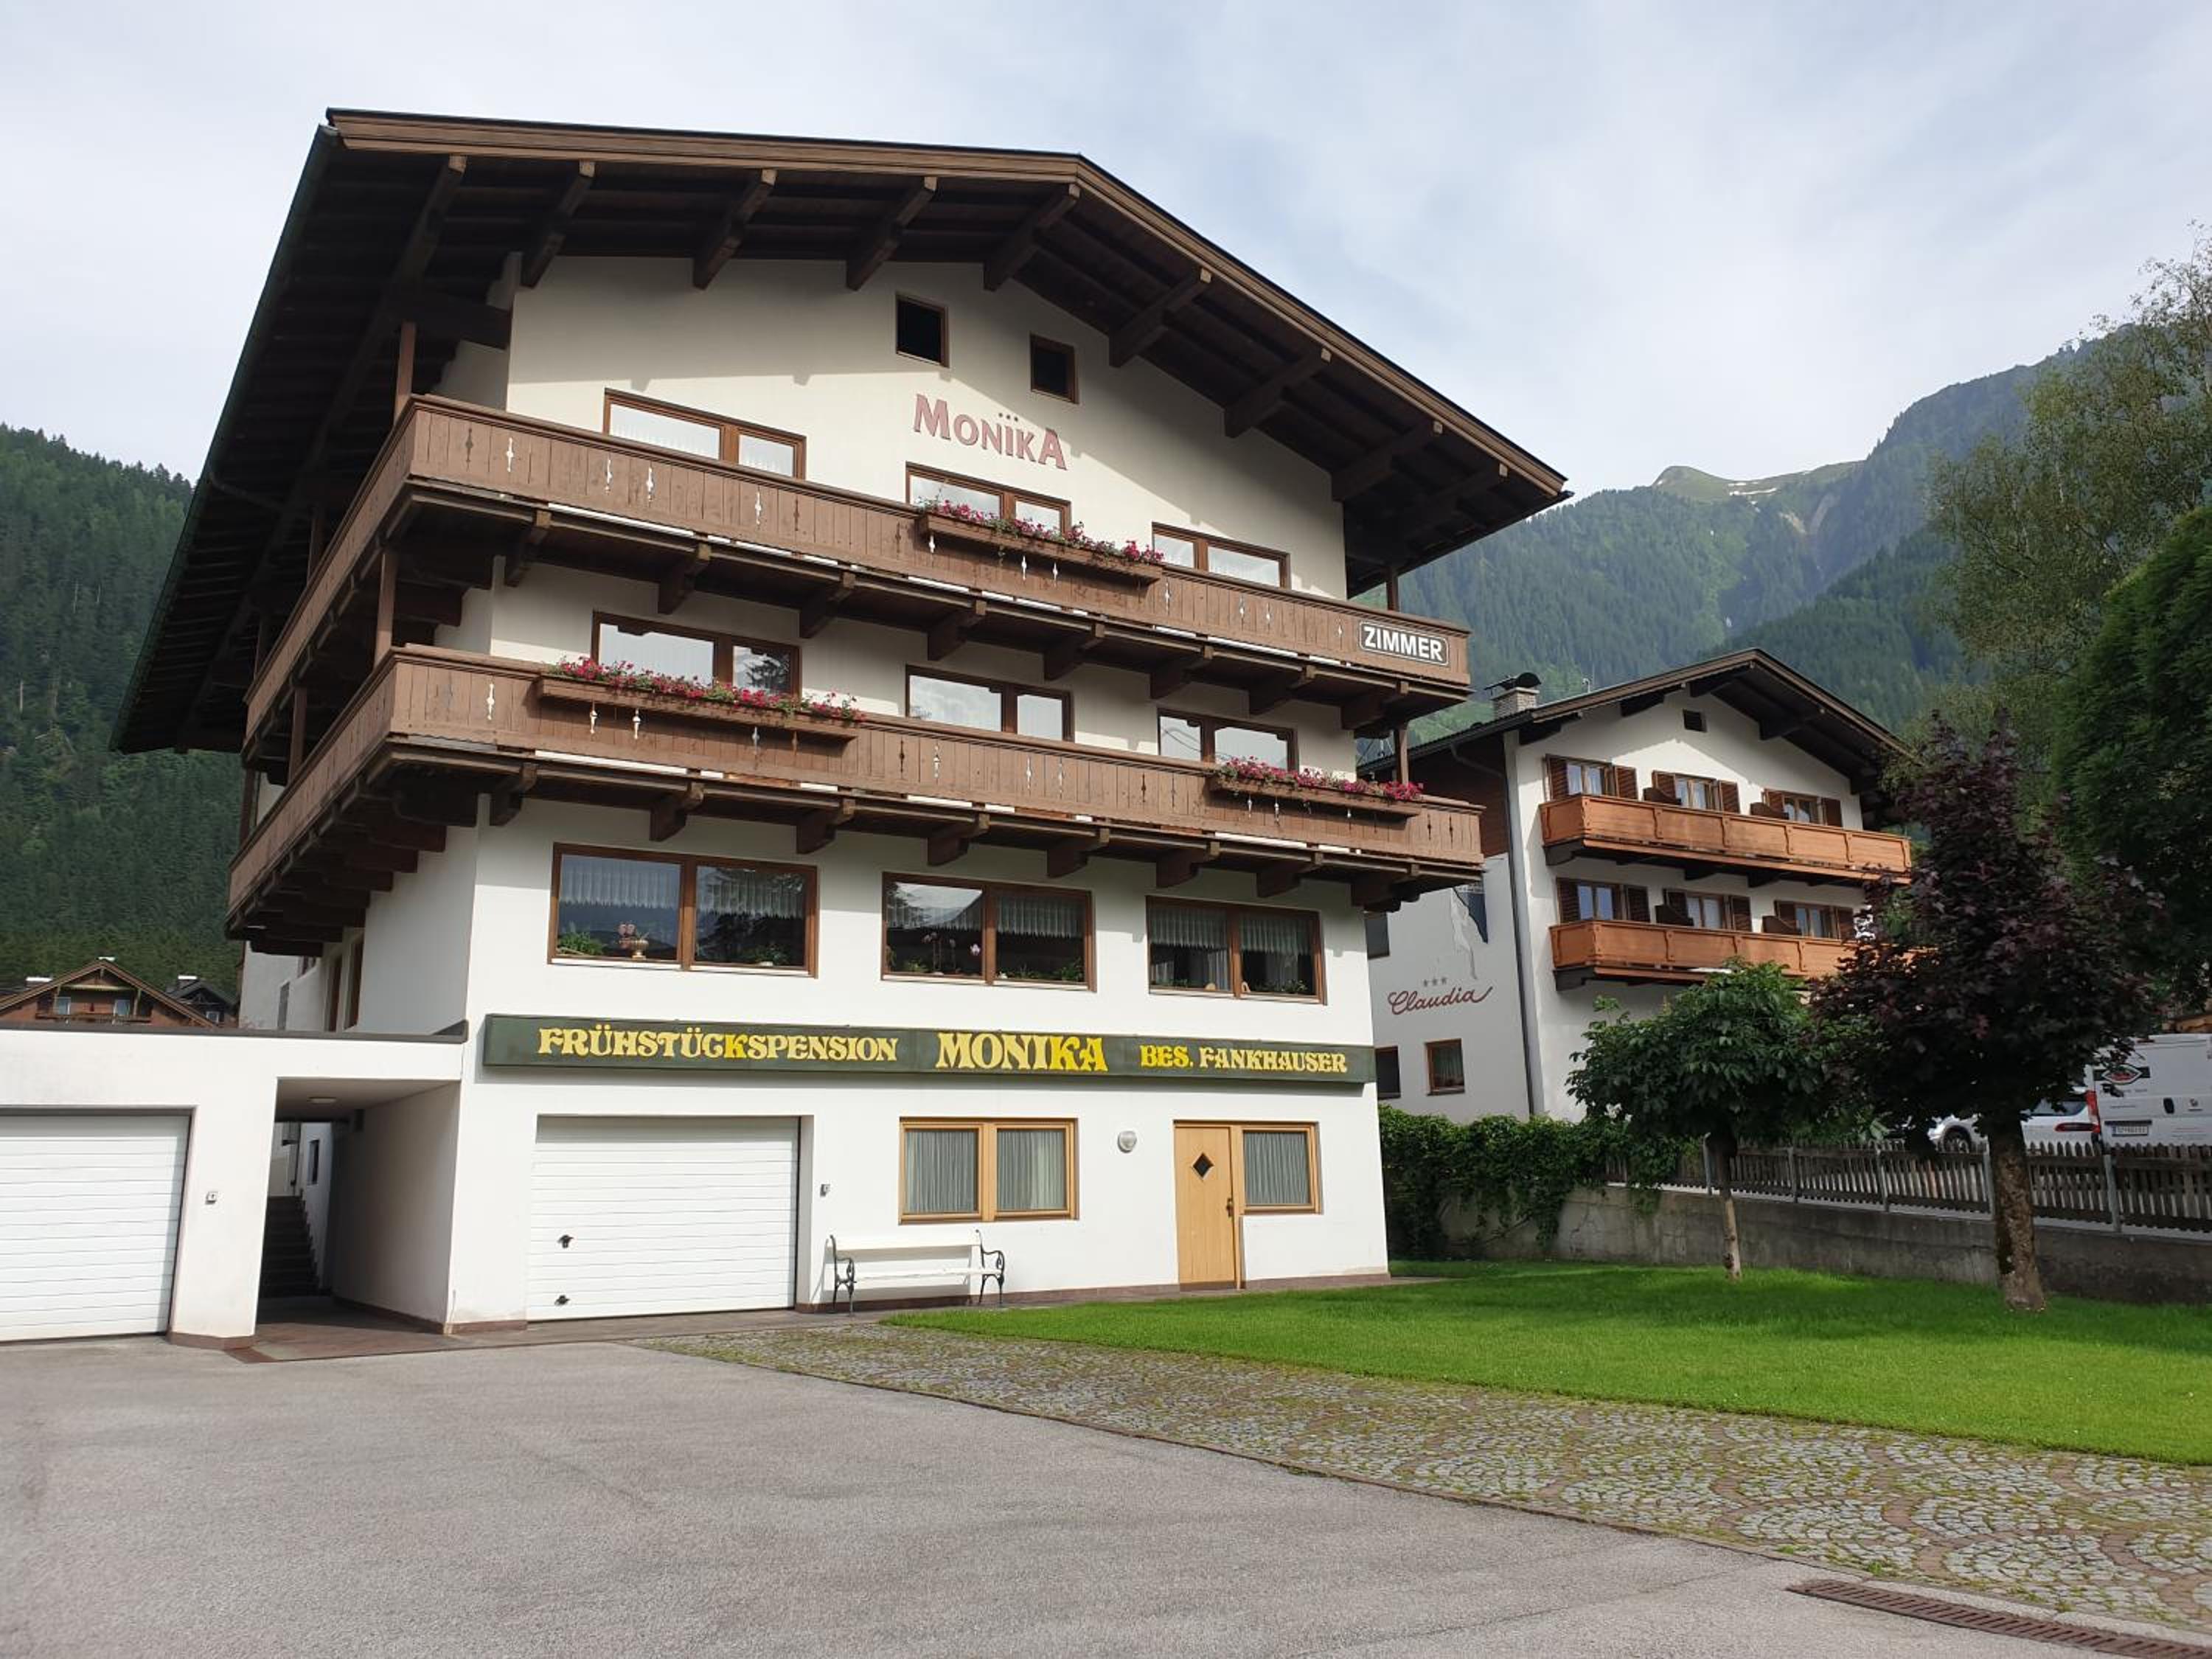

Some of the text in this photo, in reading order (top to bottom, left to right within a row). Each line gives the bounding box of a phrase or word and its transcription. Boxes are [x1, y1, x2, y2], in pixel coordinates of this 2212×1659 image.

[914, 393, 1068, 470] MONIKA
[1363, 626, 1443, 661] ZIMMER
[1388, 986, 1493, 1015] Claudia
[538, 1024, 1347, 1073] FRÜHSTÜCKSPENSION MONIKA BES. FANKHAUSER
